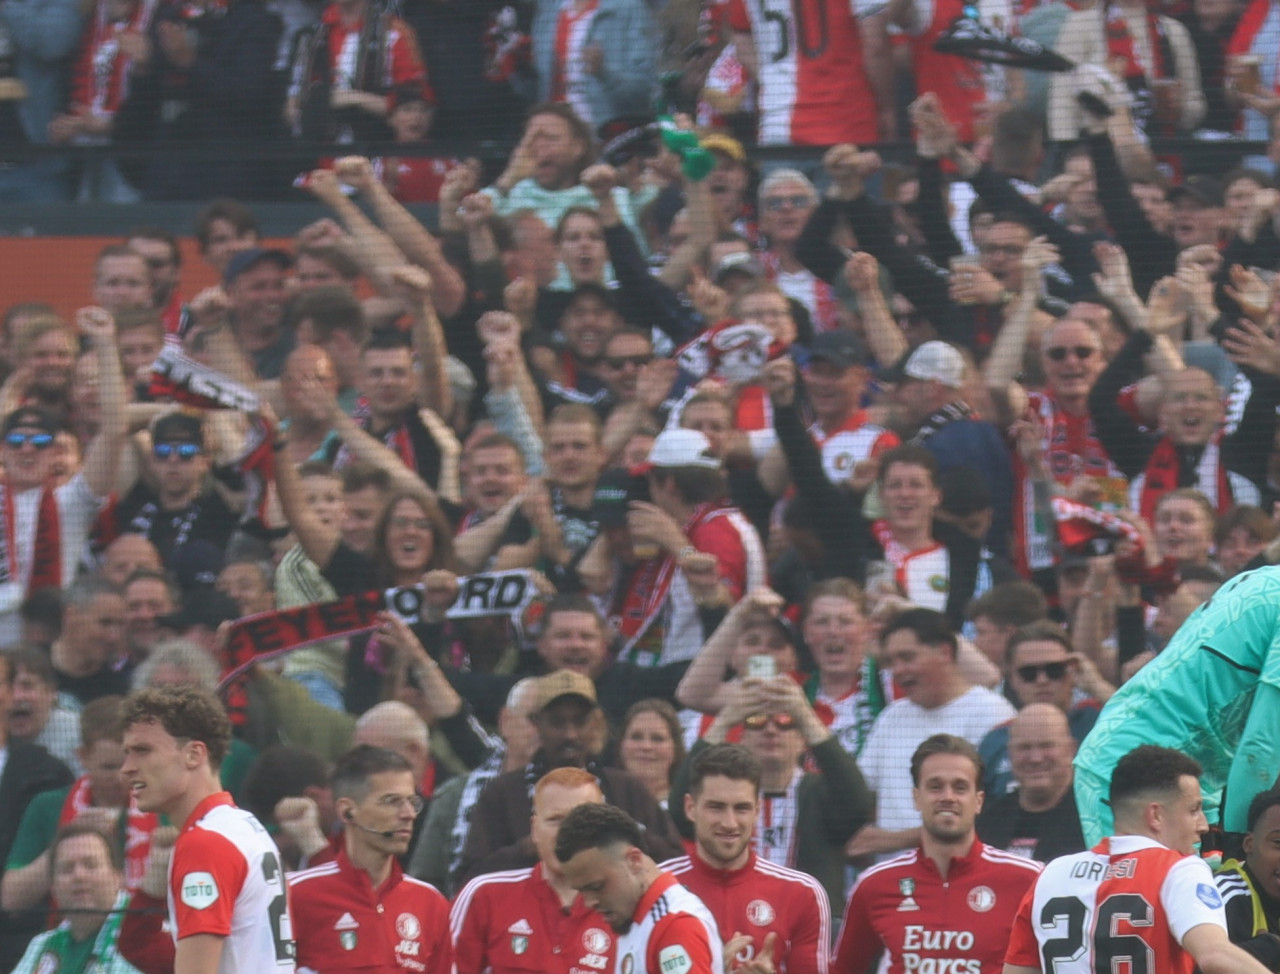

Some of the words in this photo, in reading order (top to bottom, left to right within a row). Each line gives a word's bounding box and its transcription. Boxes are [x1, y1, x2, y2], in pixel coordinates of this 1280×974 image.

[228, 573, 527, 665] FEYENORD
[183, 884, 213, 898] TOTO
[902, 925, 974, 951] Euro
[662, 955, 687, 973] TOTO
